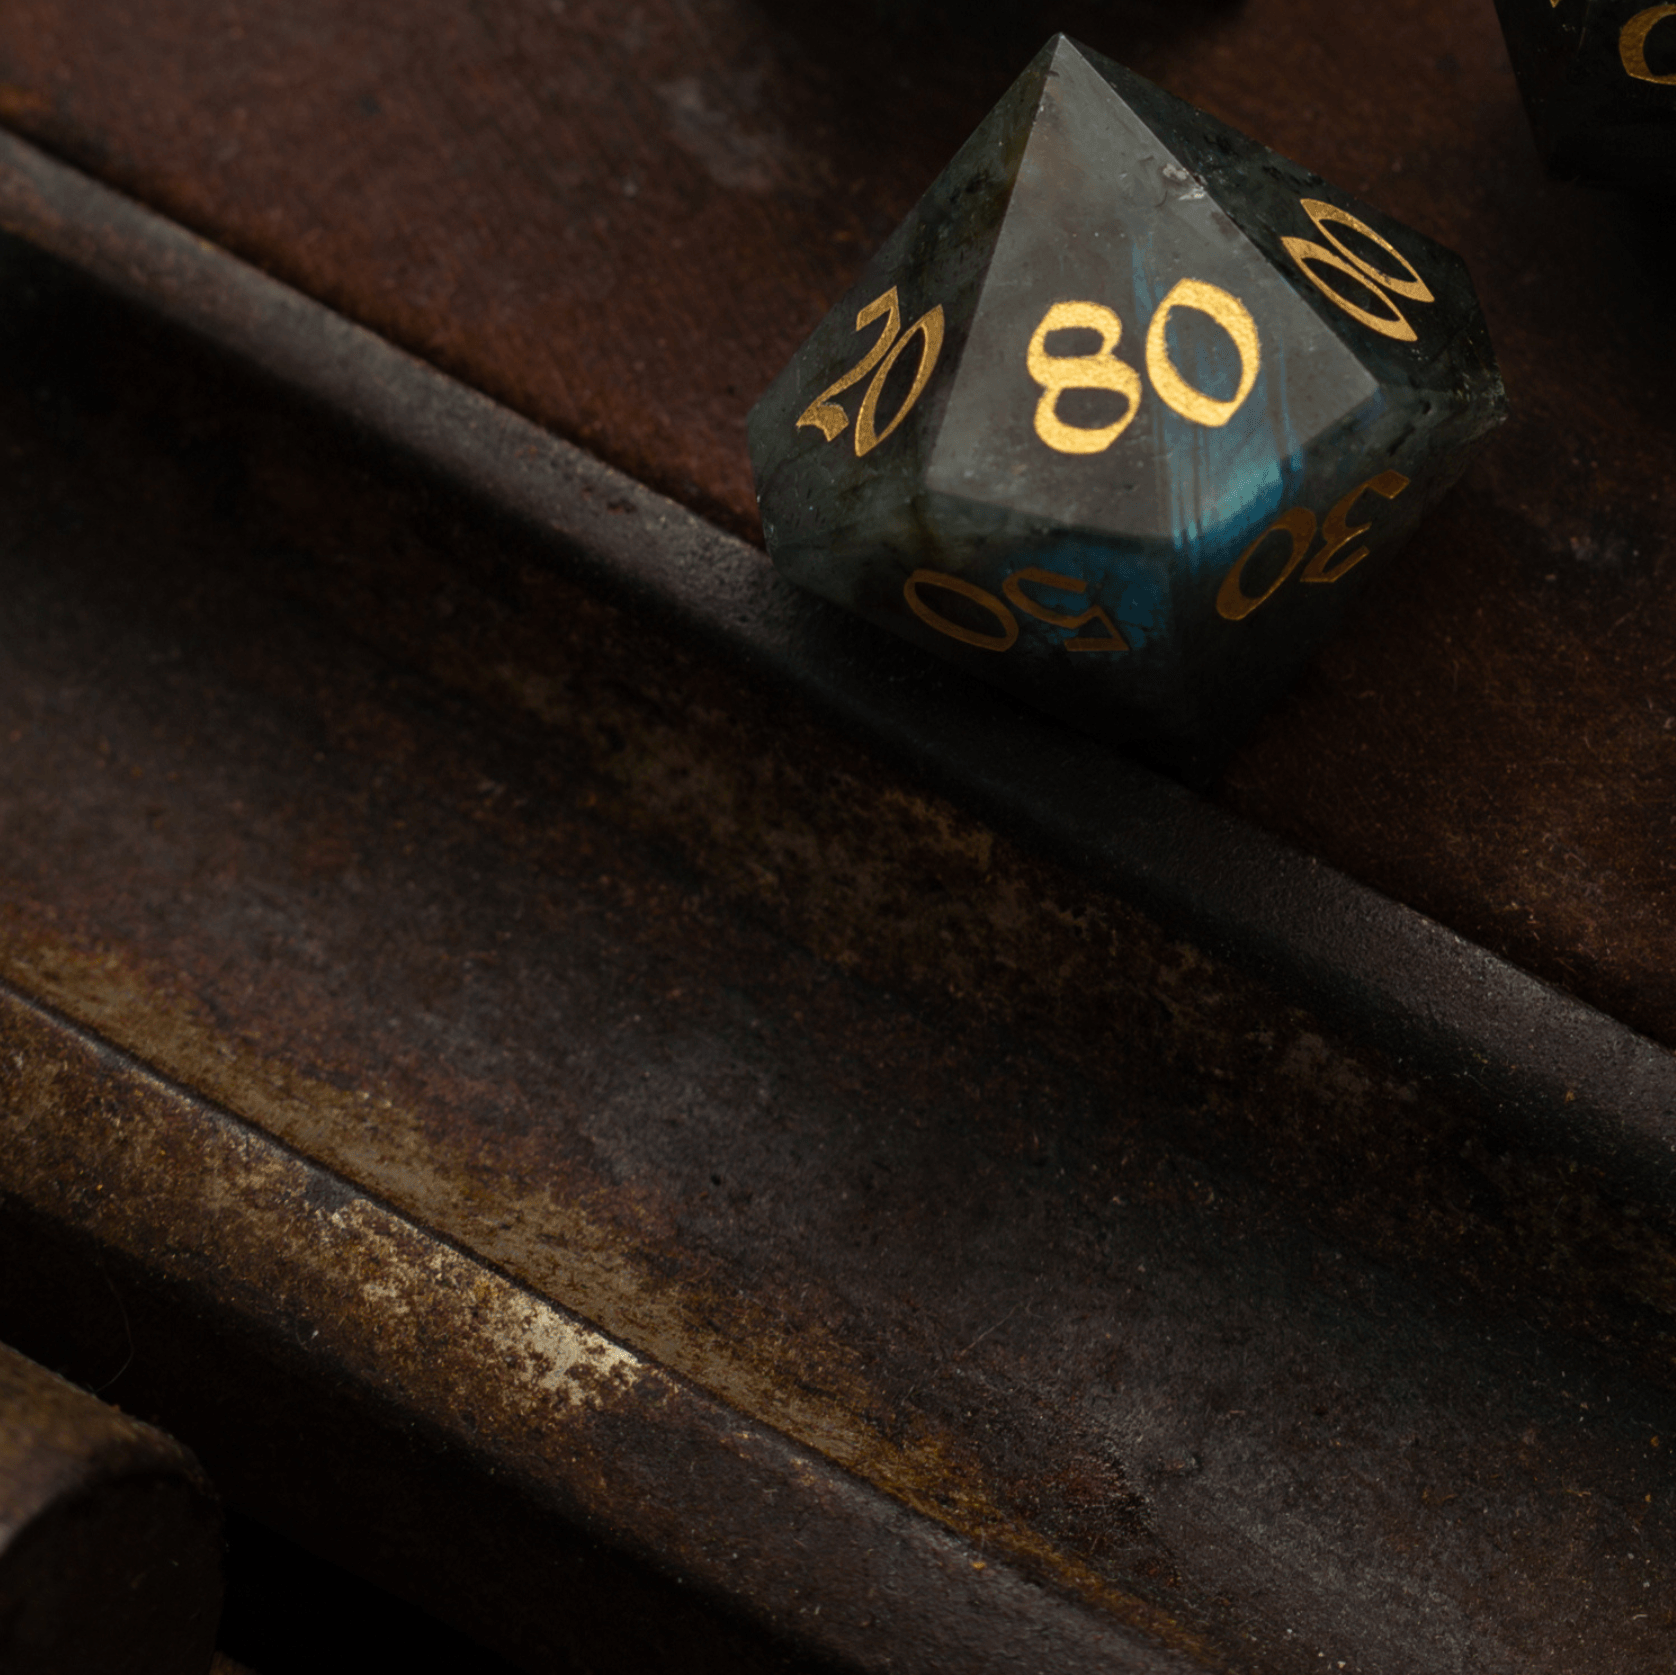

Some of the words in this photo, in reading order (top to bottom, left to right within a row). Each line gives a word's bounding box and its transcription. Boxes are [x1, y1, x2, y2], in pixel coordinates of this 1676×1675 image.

[1280, 198, 1435, 343] 00
[796, 285, 945, 457] 20
[1026, 277, 1260, 455] 80
[903, 567, 1130, 653] 50
[1215, 469, 1410, 621] 30
